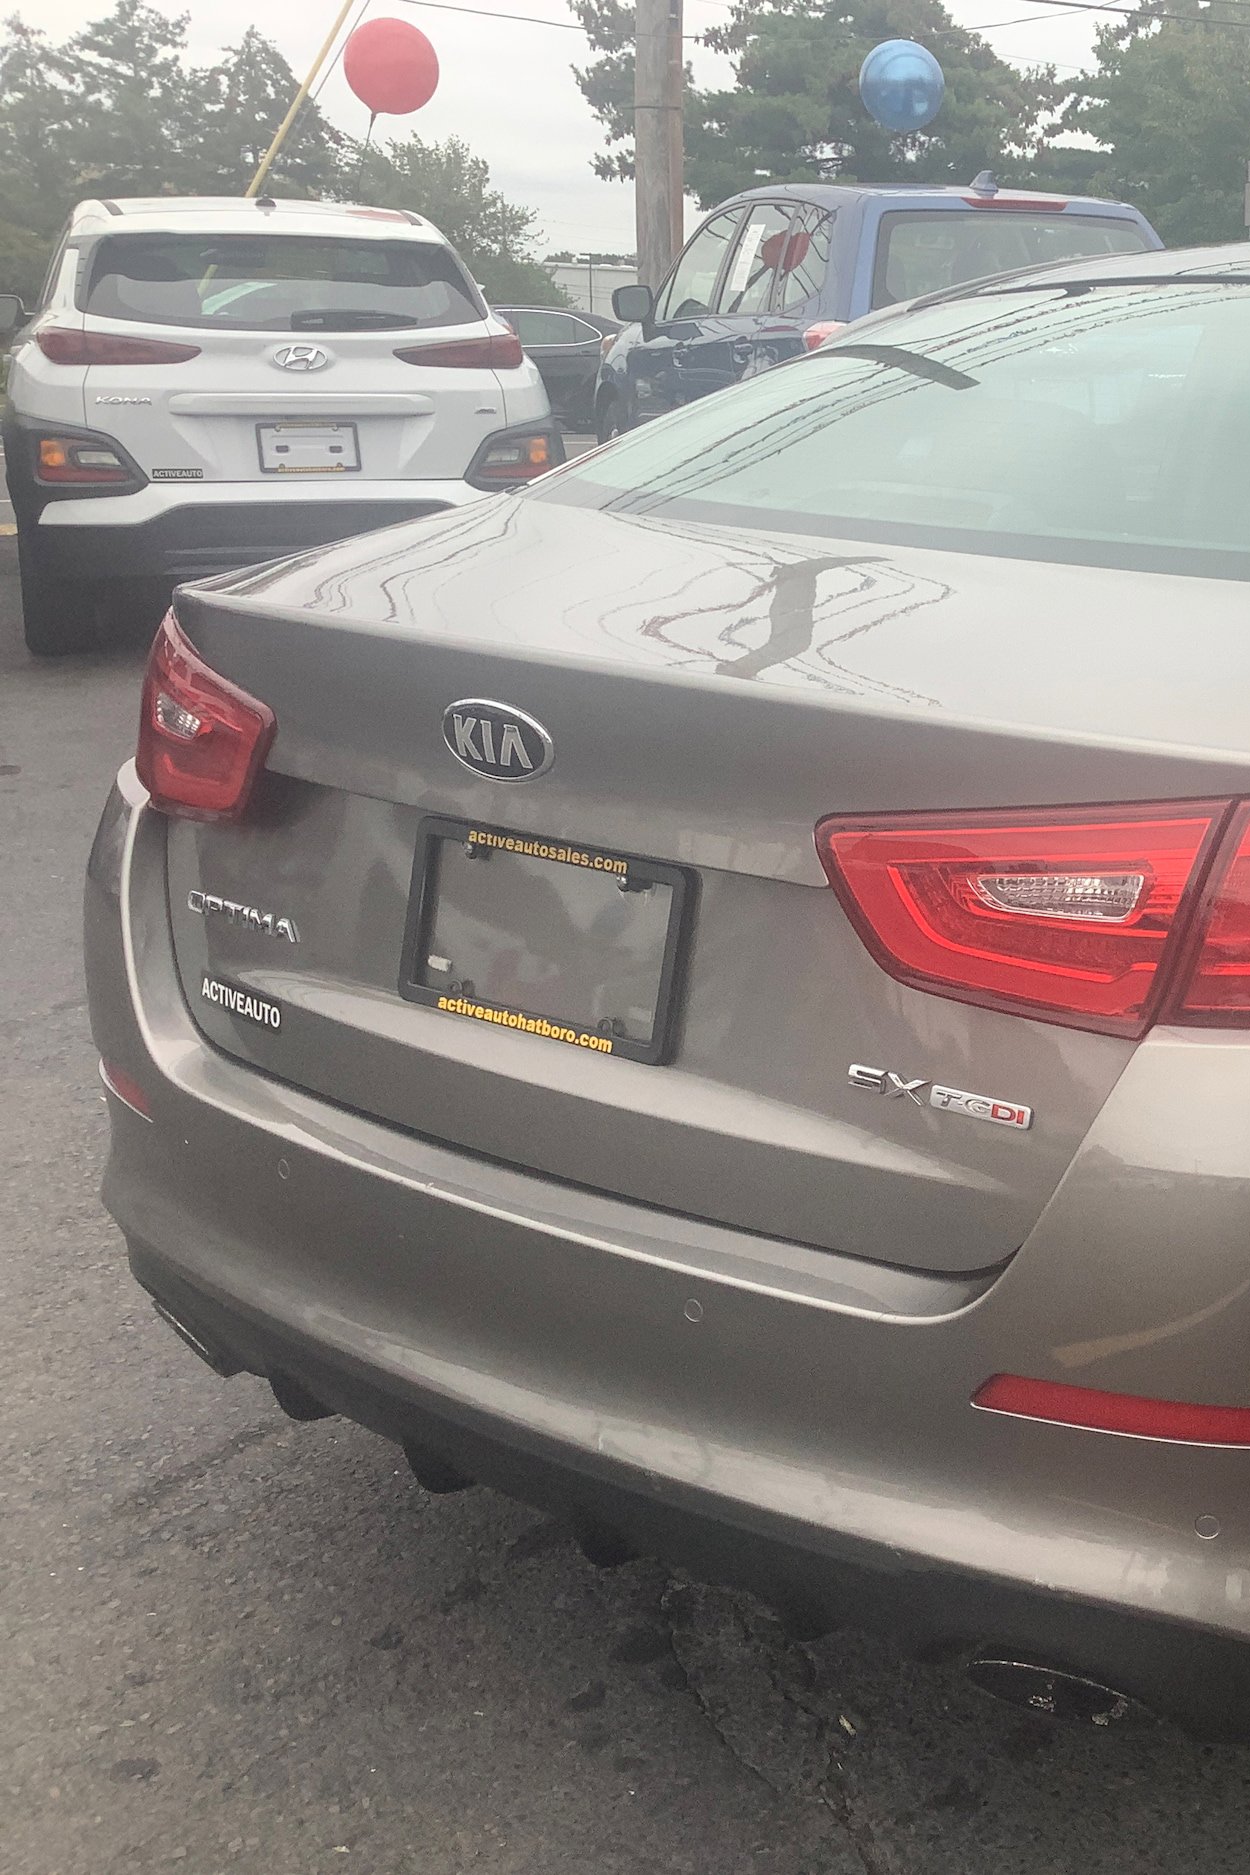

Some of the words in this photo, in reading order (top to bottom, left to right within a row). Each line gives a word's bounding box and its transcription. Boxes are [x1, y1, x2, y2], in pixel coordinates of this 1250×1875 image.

[95, 395, 152, 406] KONA
[152, 469, 203, 478] ACTIVEAUTO
[451, 713, 534, 770] KIA
[468, 828, 628, 875] activeautosales.com
[187, 890, 301, 943] OPTIMA
[202, 977, 281, 1029] ACTIVEAUTO
[437, 994, 614, 1055] activeautohatboro.com
[848, 1063, 932, 1107] SX
